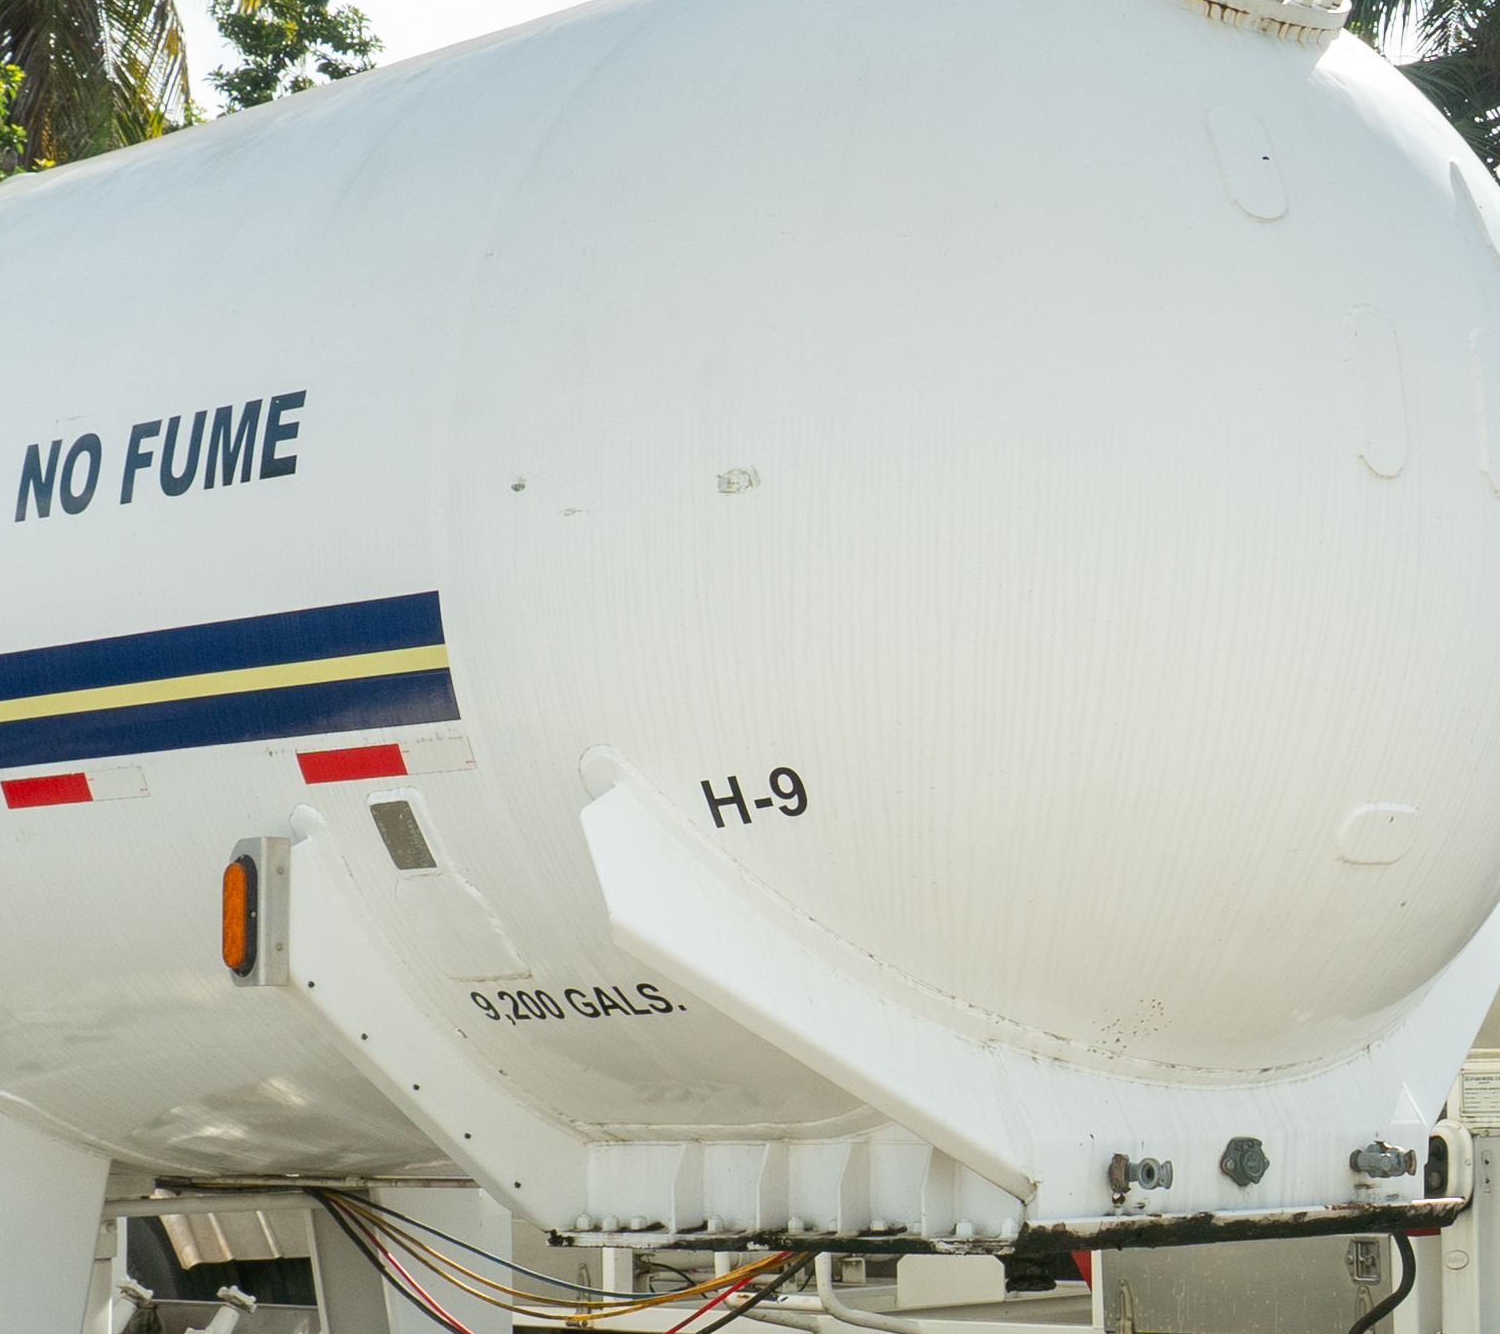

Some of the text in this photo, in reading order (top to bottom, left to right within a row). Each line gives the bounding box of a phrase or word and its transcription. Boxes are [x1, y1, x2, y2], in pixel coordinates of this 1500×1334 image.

[14, 389, 307, 523] NO FUME
[700, 766, 808, 829] H-9
[469, 982, 688, 1027] 9,200 GALS.
